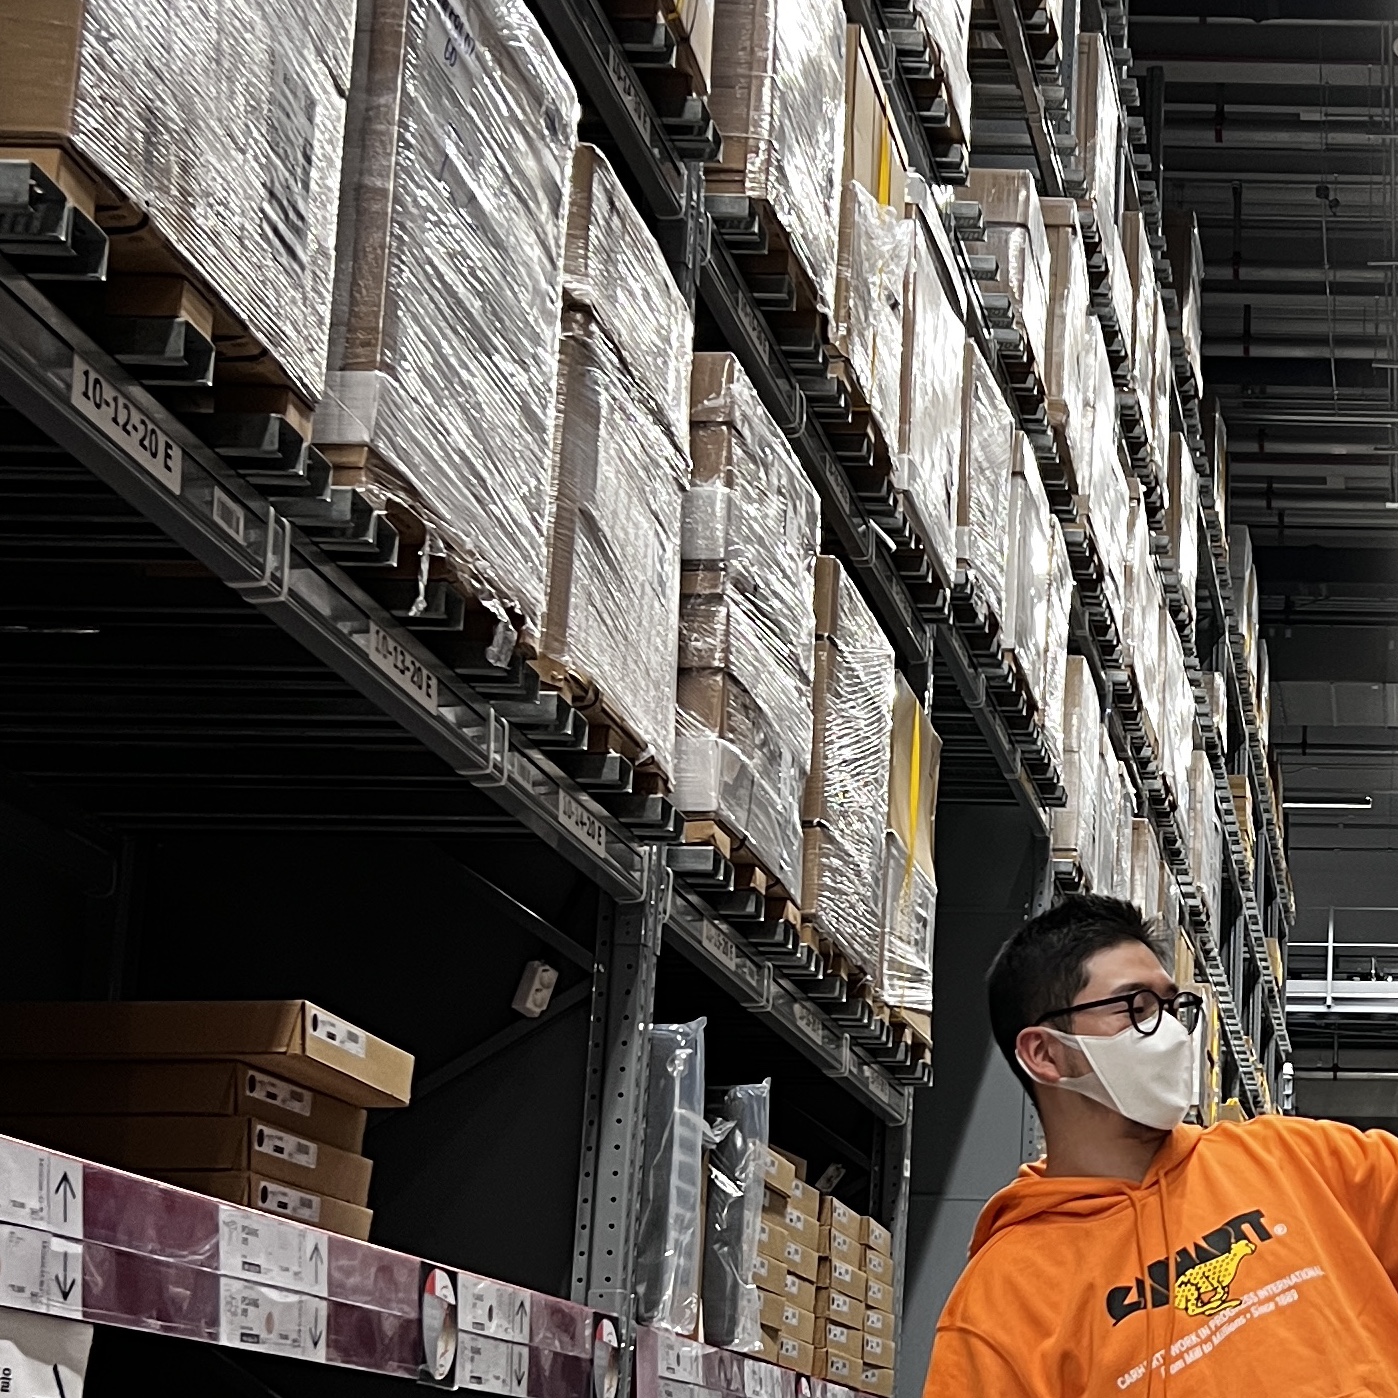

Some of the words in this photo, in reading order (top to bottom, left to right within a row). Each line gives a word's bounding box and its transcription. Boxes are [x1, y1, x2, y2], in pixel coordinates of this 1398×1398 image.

[81, 368, 160, 460] 10-12-20
[162, 439, 175, 474] E
[374, 628, 424, 691] 10-13-20
[425, 673, 433, 700] E
[597, 824, 602, 847] E
[1160, 1358, 1186, 1380] Fom
[1202, 1341, 1214, 1355] to
[1211, 1315, 1247, 1347] Millions
[1250, 1301, 1276, 1319] Since
[1170, 1332, 1201, 1357] WORK
[1197, 1325, 1211, 1340] IN
[1256, 1265, 1326, 1301] INTERNATIONAL
